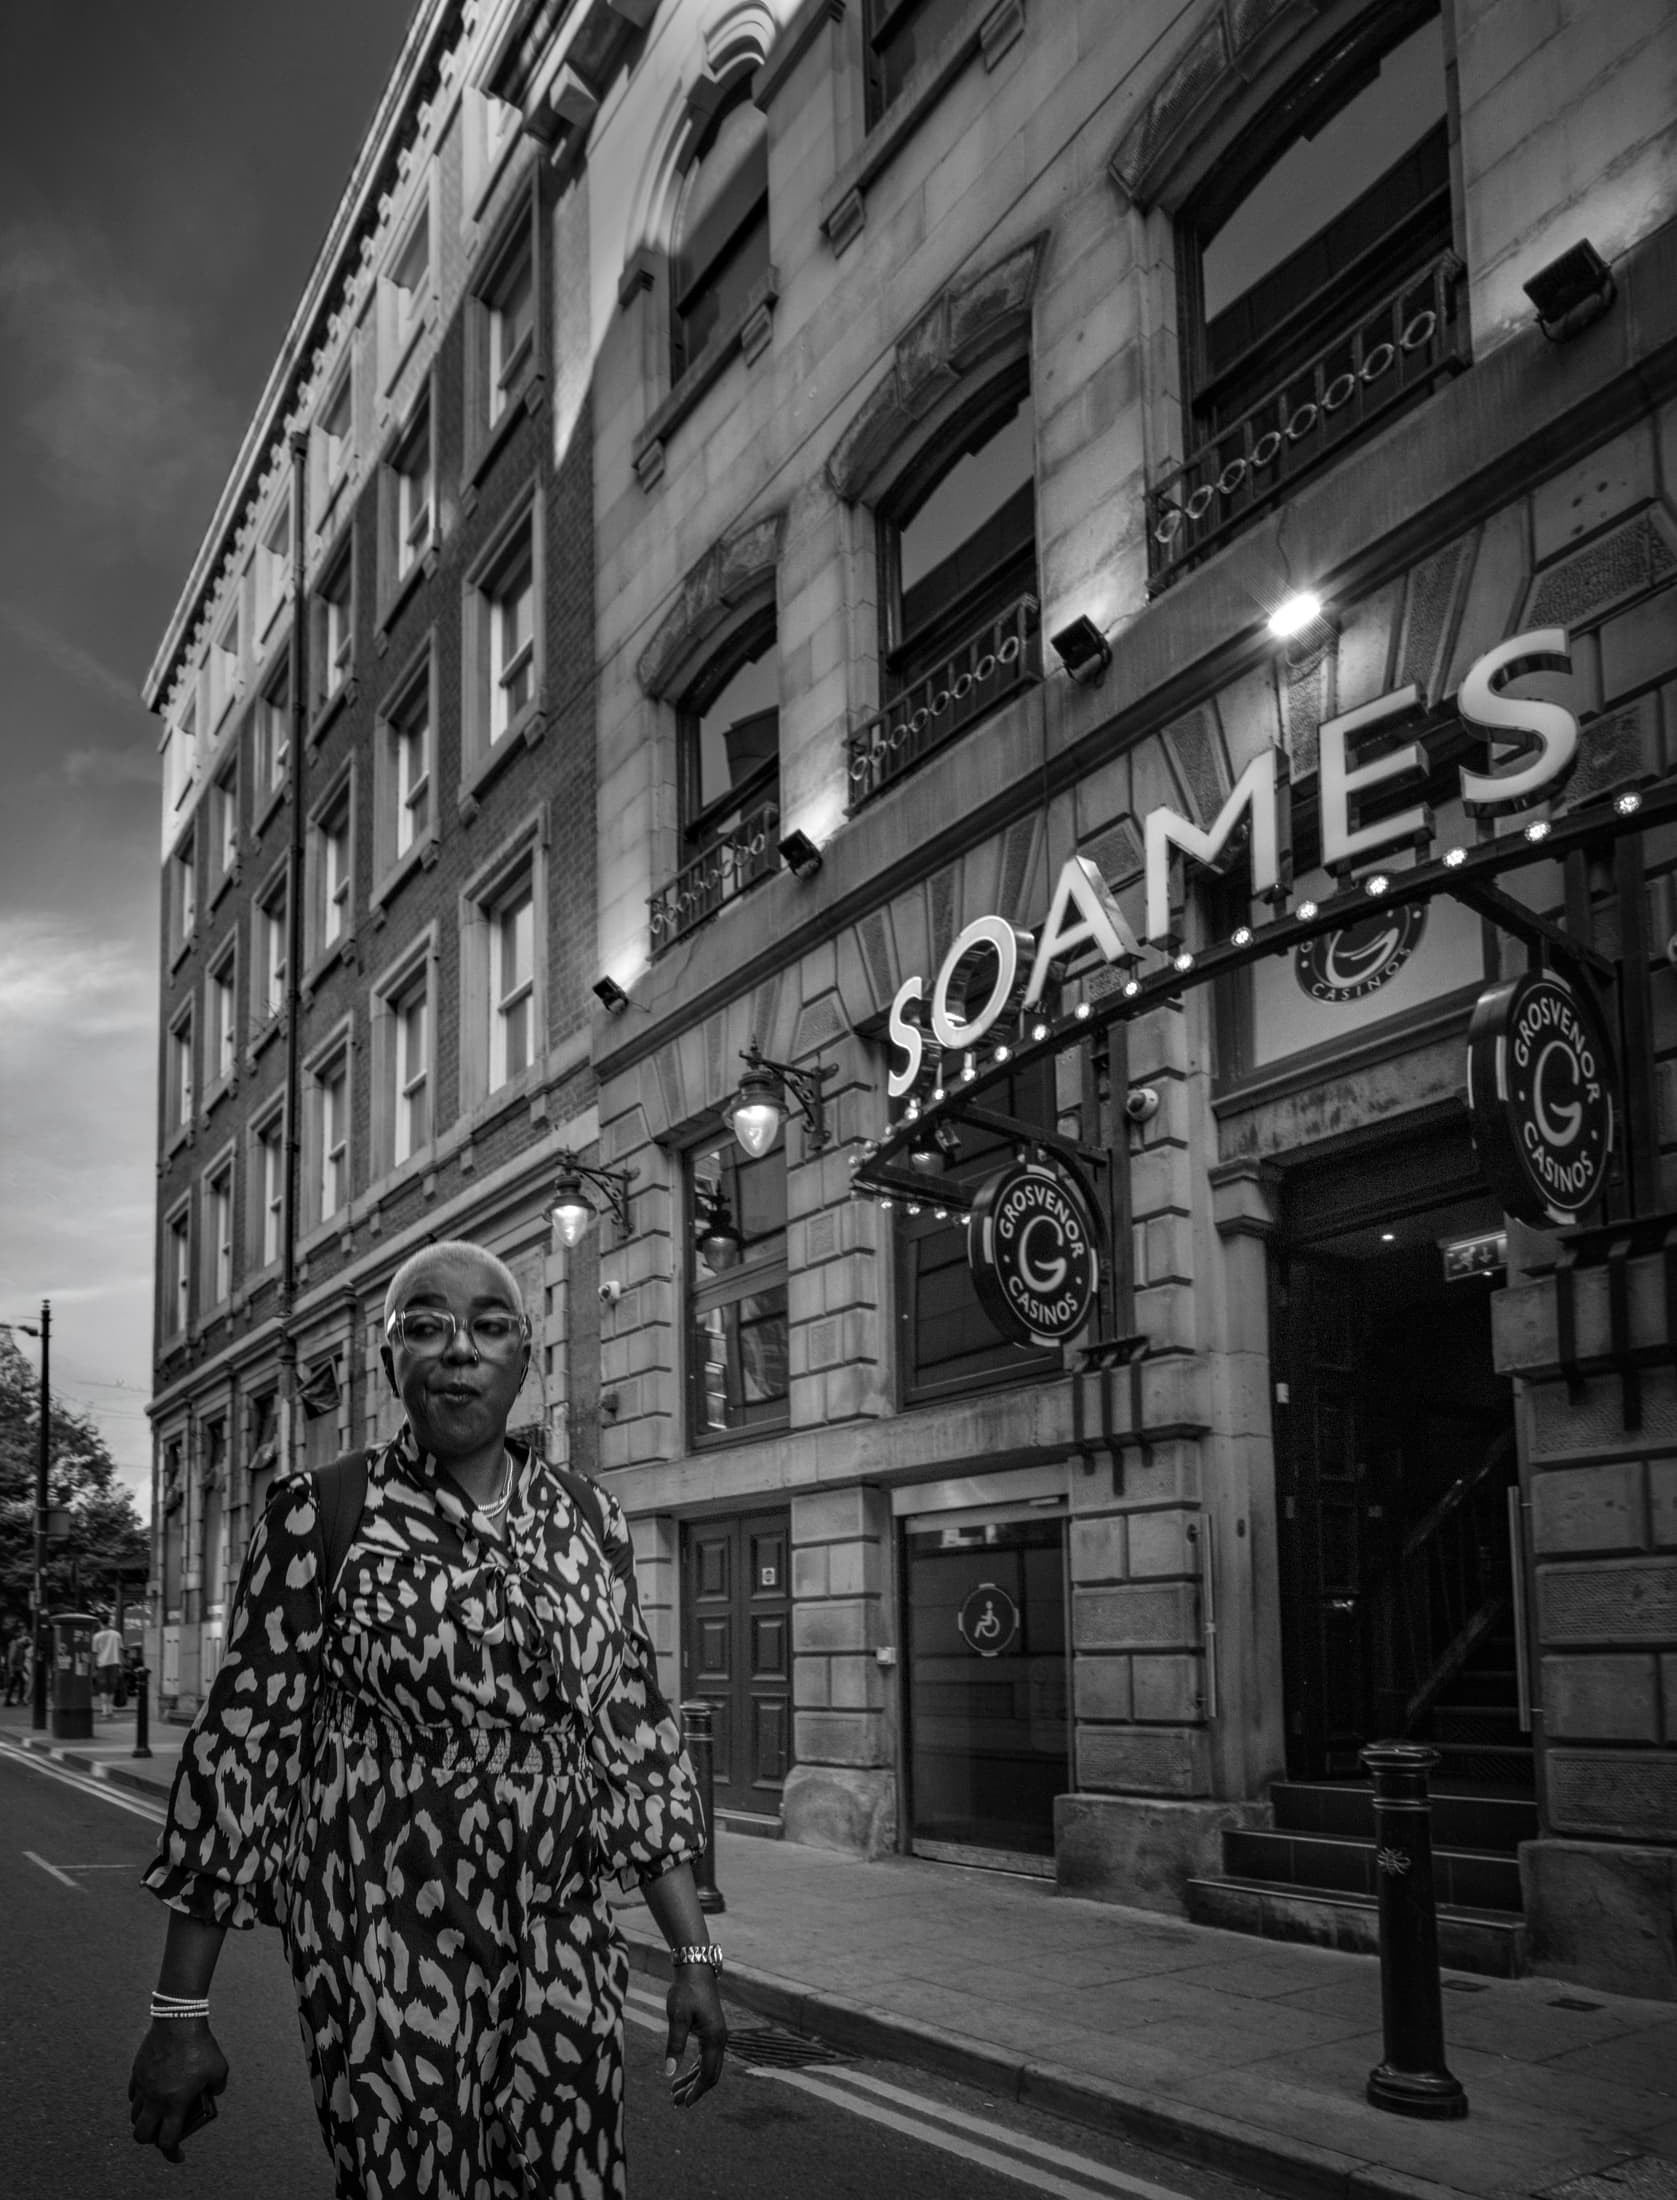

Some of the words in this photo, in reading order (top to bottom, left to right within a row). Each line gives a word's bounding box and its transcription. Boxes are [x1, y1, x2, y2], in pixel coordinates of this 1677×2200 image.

[888, 627, 1580, 1097] SOAMES
[1311, 948, 1411, 1001] CASINOS
[1514, 997, 1600, 1104] GROSVENOR
[1533, 1040, 1583, 1147] G
[1524, 1121, 1594, 1193] CASINOS
[1000, 1185, 1084, 1259] GROSVENOR
[1018, 1215, 1067, 1293] G
[1008, 1275, 1078, 1325] CASINOS
